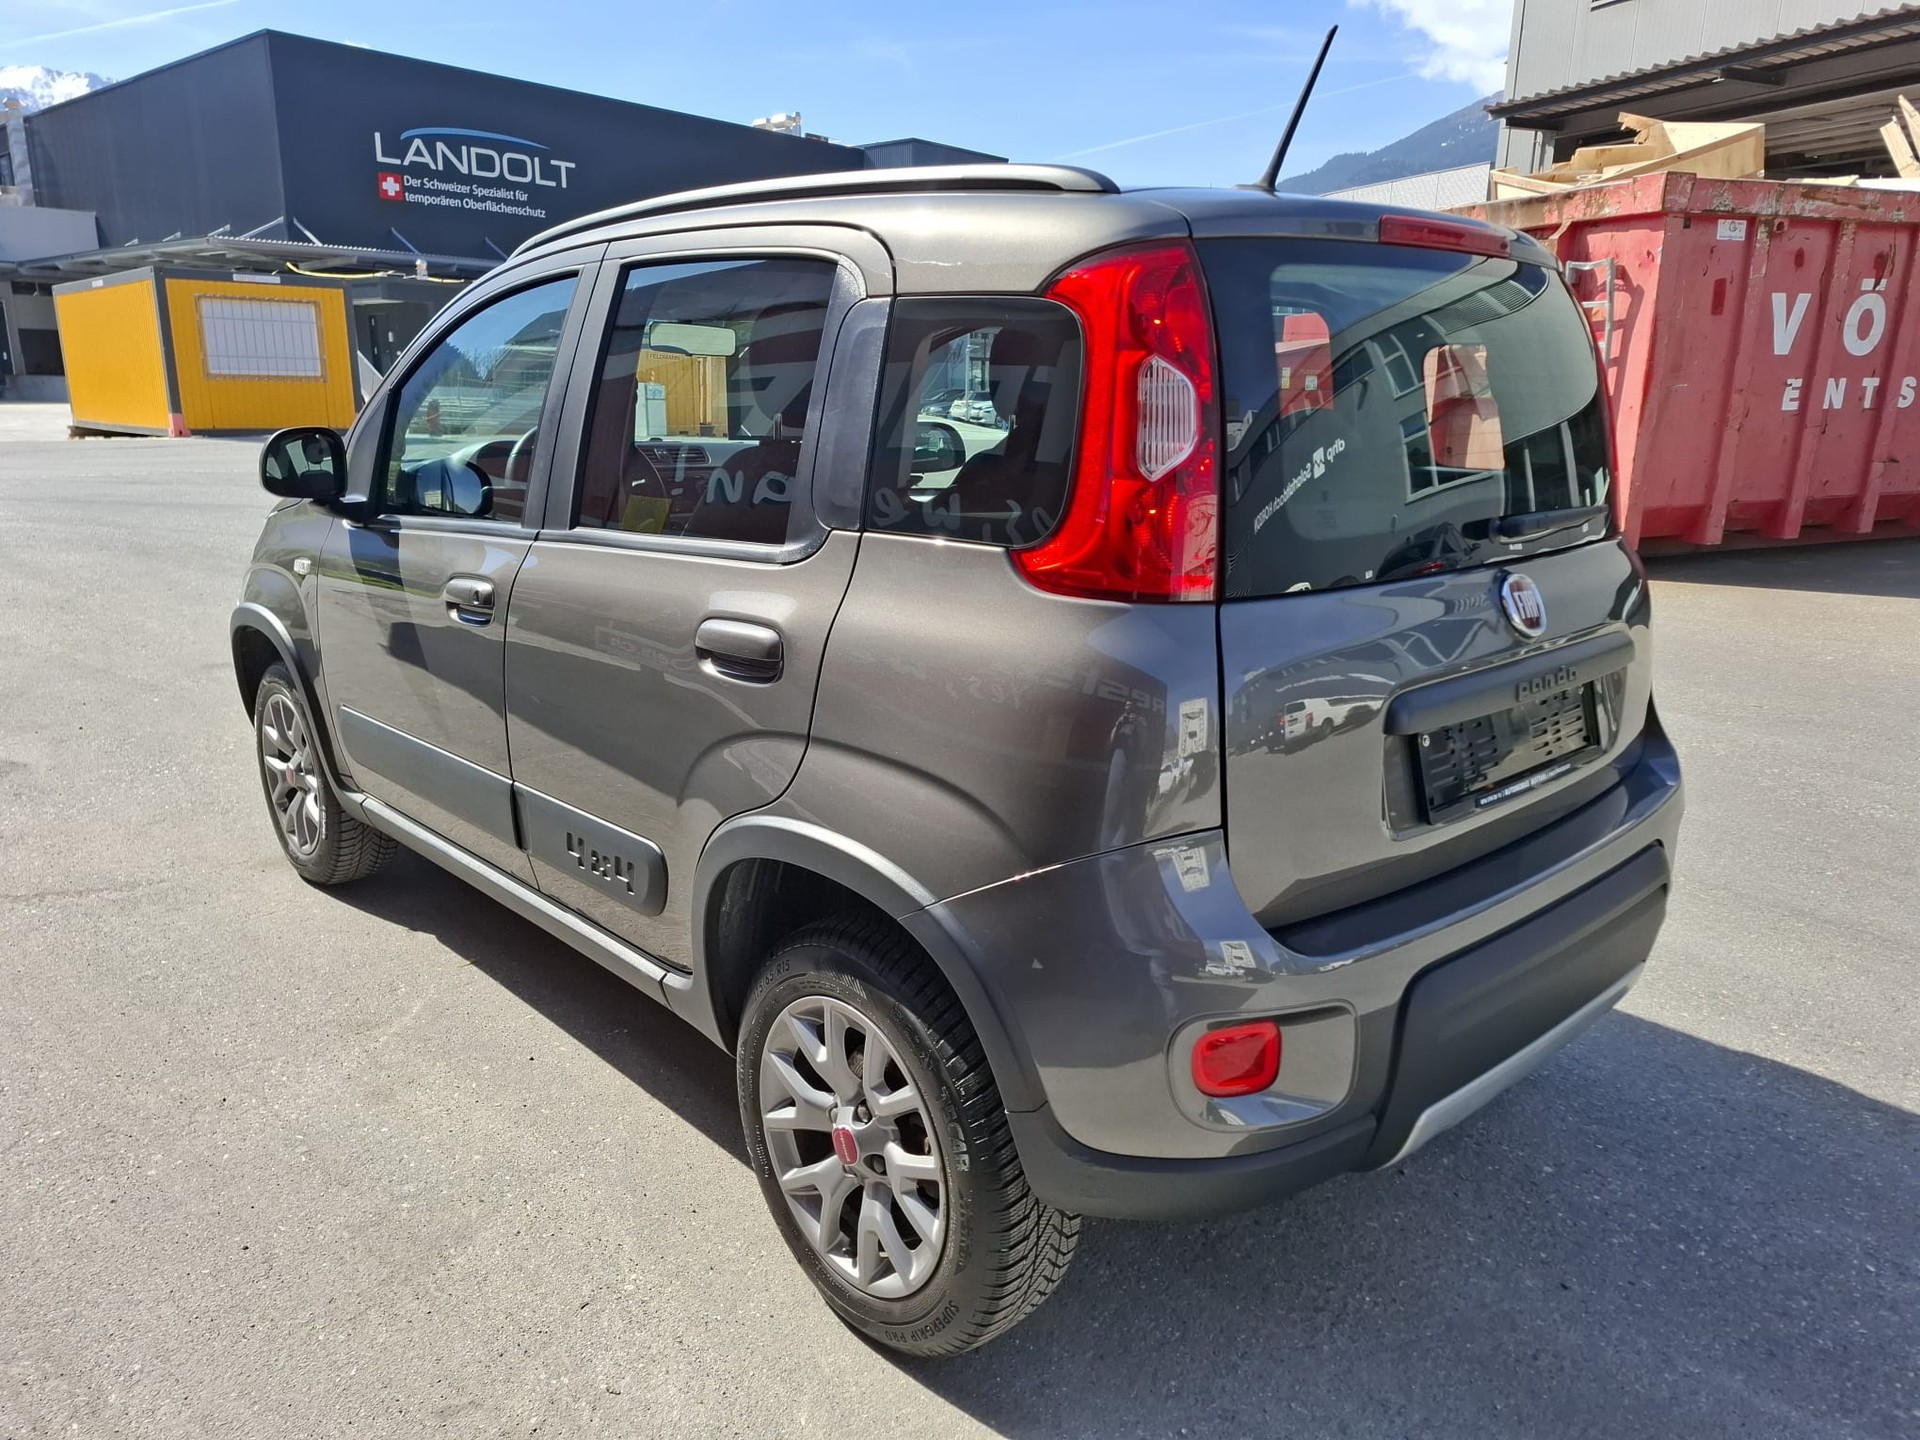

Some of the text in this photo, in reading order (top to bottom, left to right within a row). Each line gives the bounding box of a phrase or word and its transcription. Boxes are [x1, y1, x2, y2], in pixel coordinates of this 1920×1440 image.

[374, 132, 576, 189] LANDOLT
[403, 175, 528, 202] Der Schweizer Spezialist für
[404, 191, 547, 218] temporären Oberflächenschutz
[1513, 590, 1540, 619] FIAT
